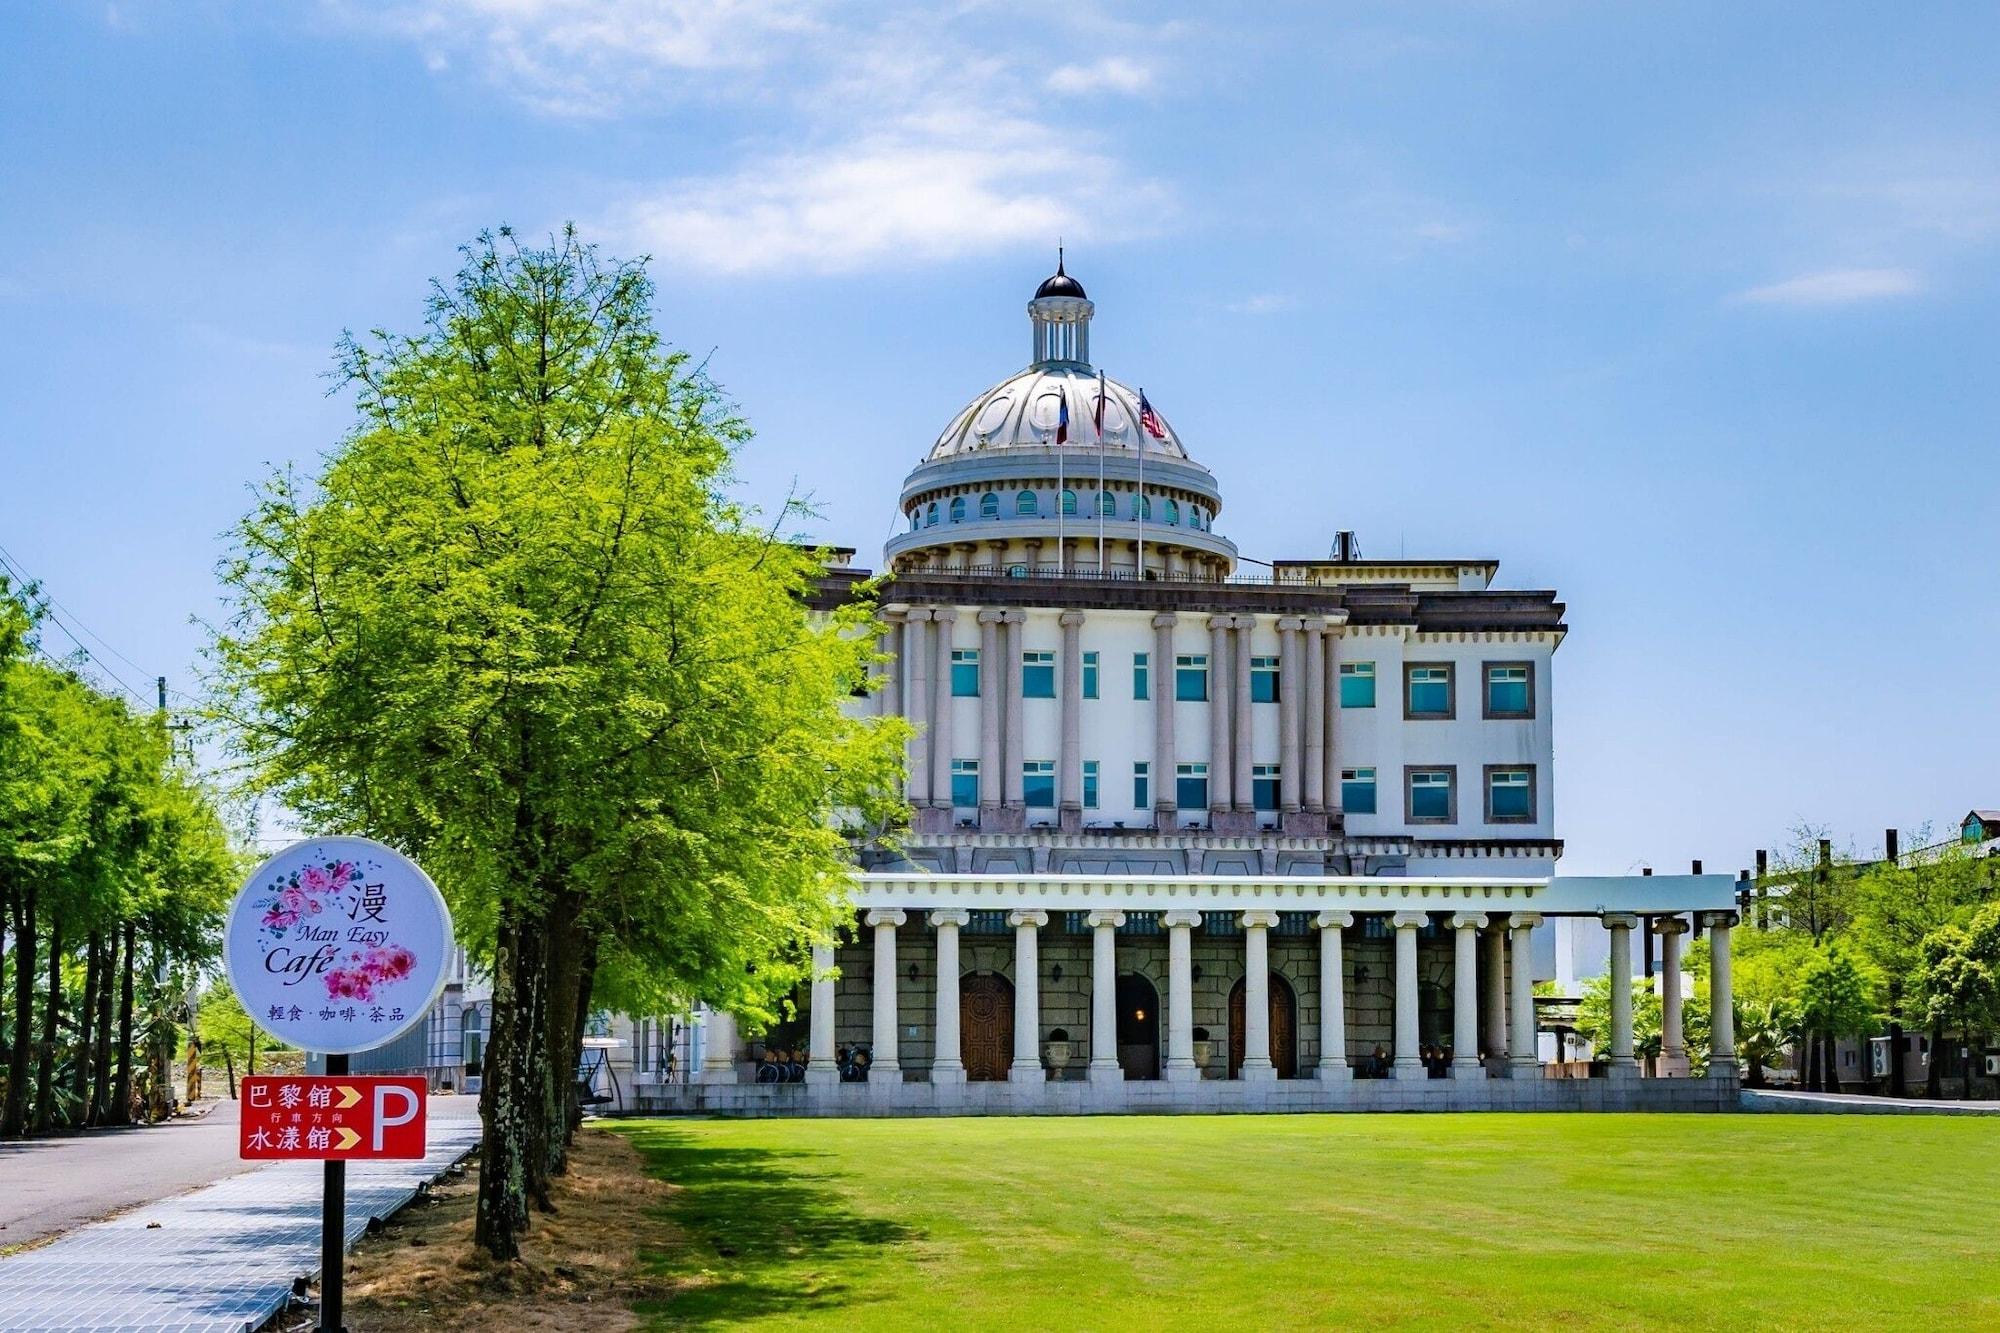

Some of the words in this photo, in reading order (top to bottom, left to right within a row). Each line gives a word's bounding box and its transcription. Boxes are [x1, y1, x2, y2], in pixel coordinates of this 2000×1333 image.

[347, 882, 389, 924] 漫
[295, 925, 338, 942] Man
[347, 926, 389, 948] Easy
[265, 944, 341, 986] Café
[250, 1084, 333, 1109] 巴黎館
[270, 1112, 343, 1124] 行車方向
[372, 1085, 419, 1151] P
[246, 1126, 332, 1150] 水漾館
